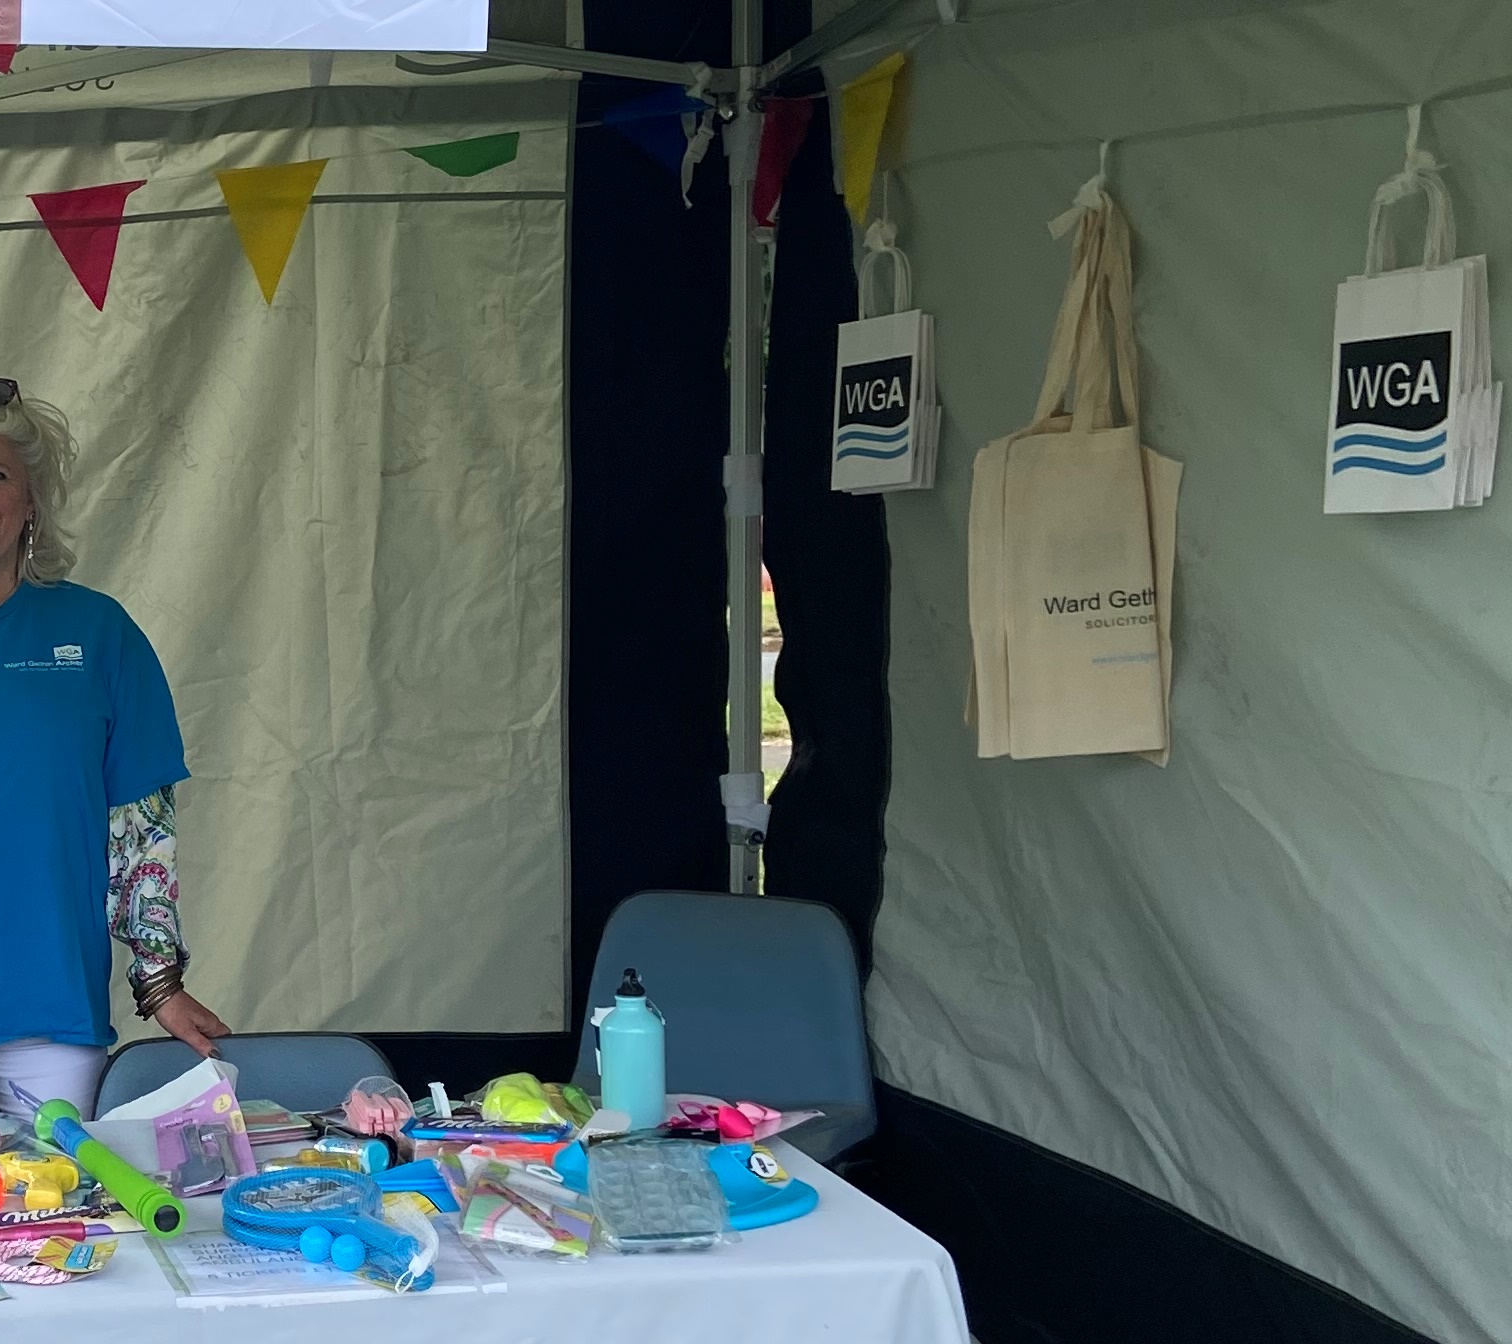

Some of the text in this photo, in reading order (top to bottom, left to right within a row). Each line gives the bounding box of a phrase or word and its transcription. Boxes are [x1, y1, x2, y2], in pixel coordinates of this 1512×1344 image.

[844, 376, 905, 414] WGA
[1345, 359, 1441, 411] WGA
[1044, 592, 1101, 615] Ward
